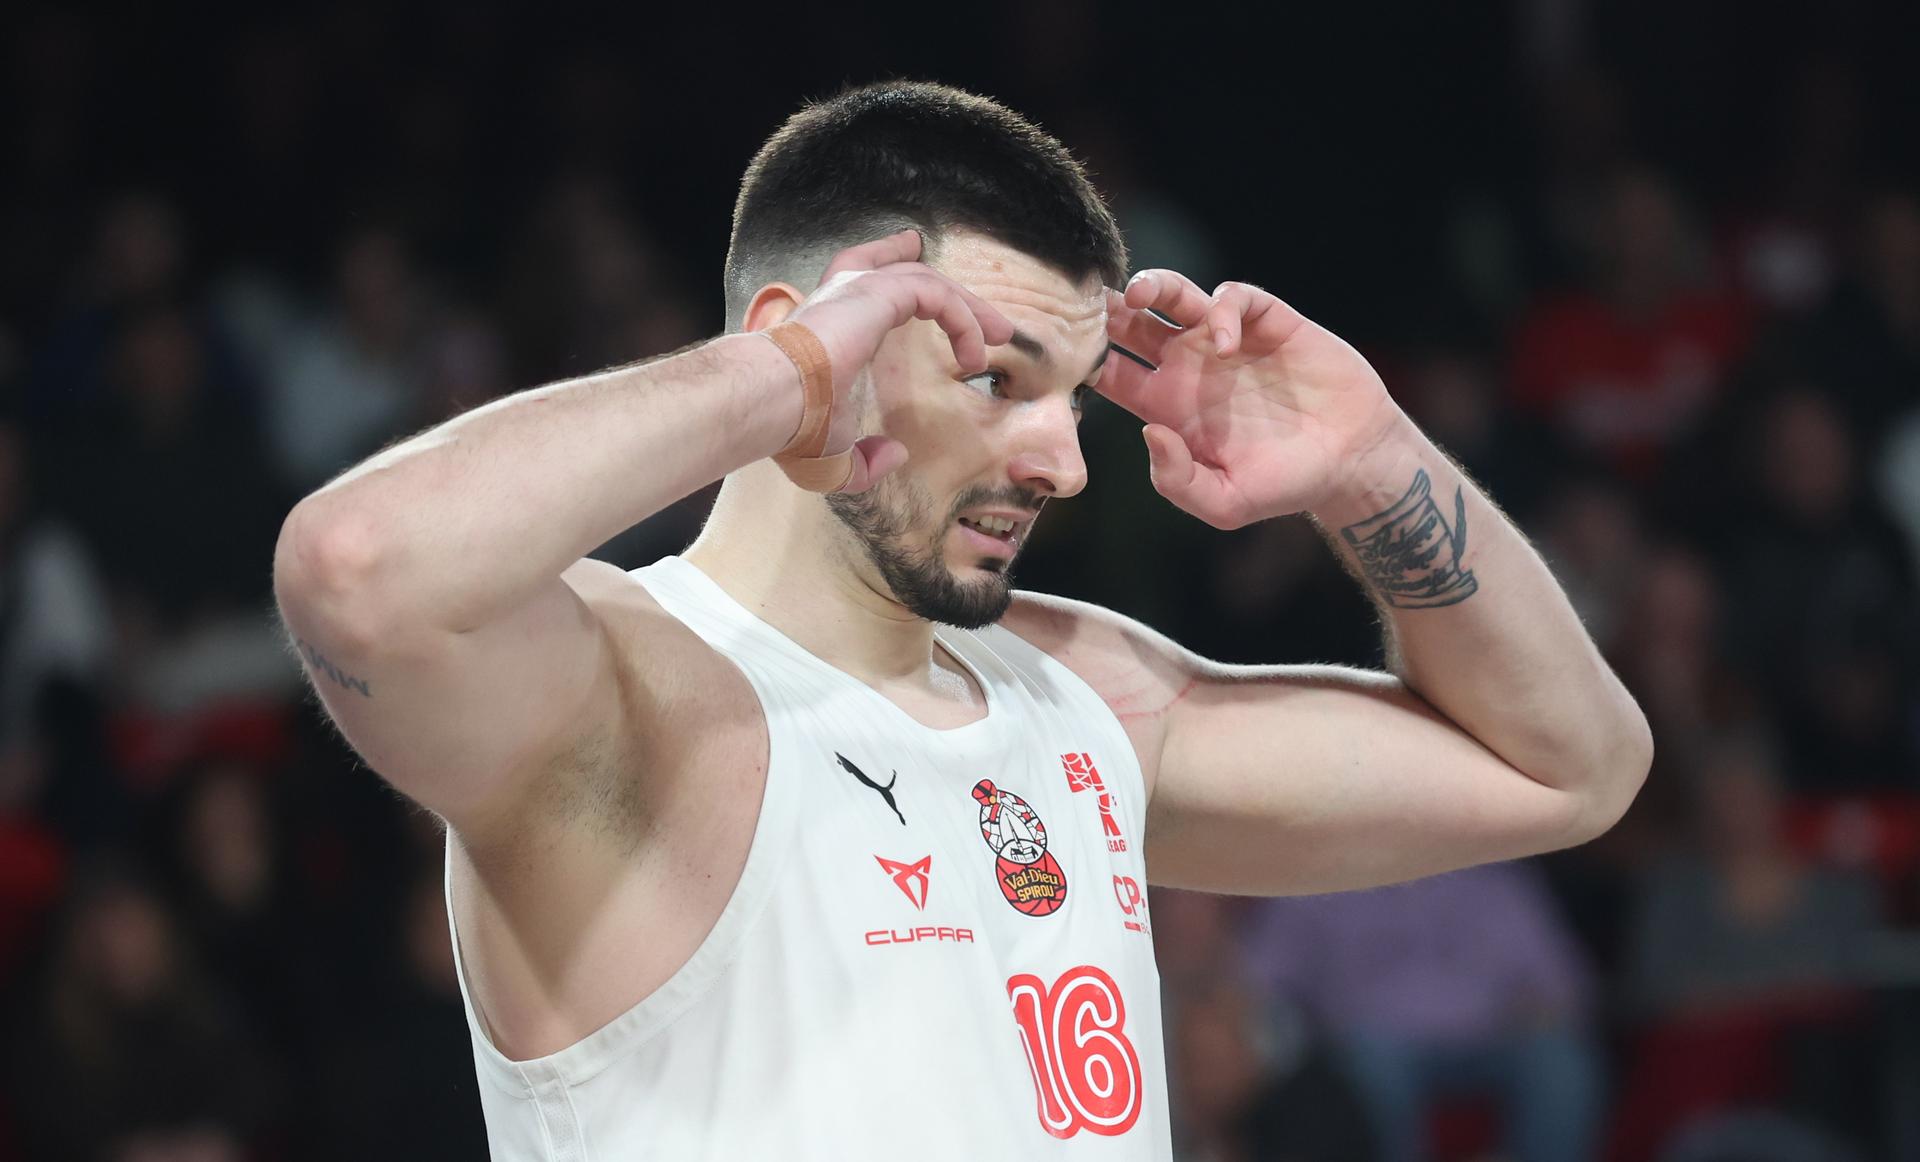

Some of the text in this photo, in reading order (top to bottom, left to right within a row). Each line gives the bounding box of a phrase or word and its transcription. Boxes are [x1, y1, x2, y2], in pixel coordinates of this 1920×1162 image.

[1004, 868, 1059, 890] Val-Dieu
[1017, 884, 1055, 902] SPIROU
[865, 927, 974, 945] CUPRA
[1006, 965, 1142, 1139] 16
